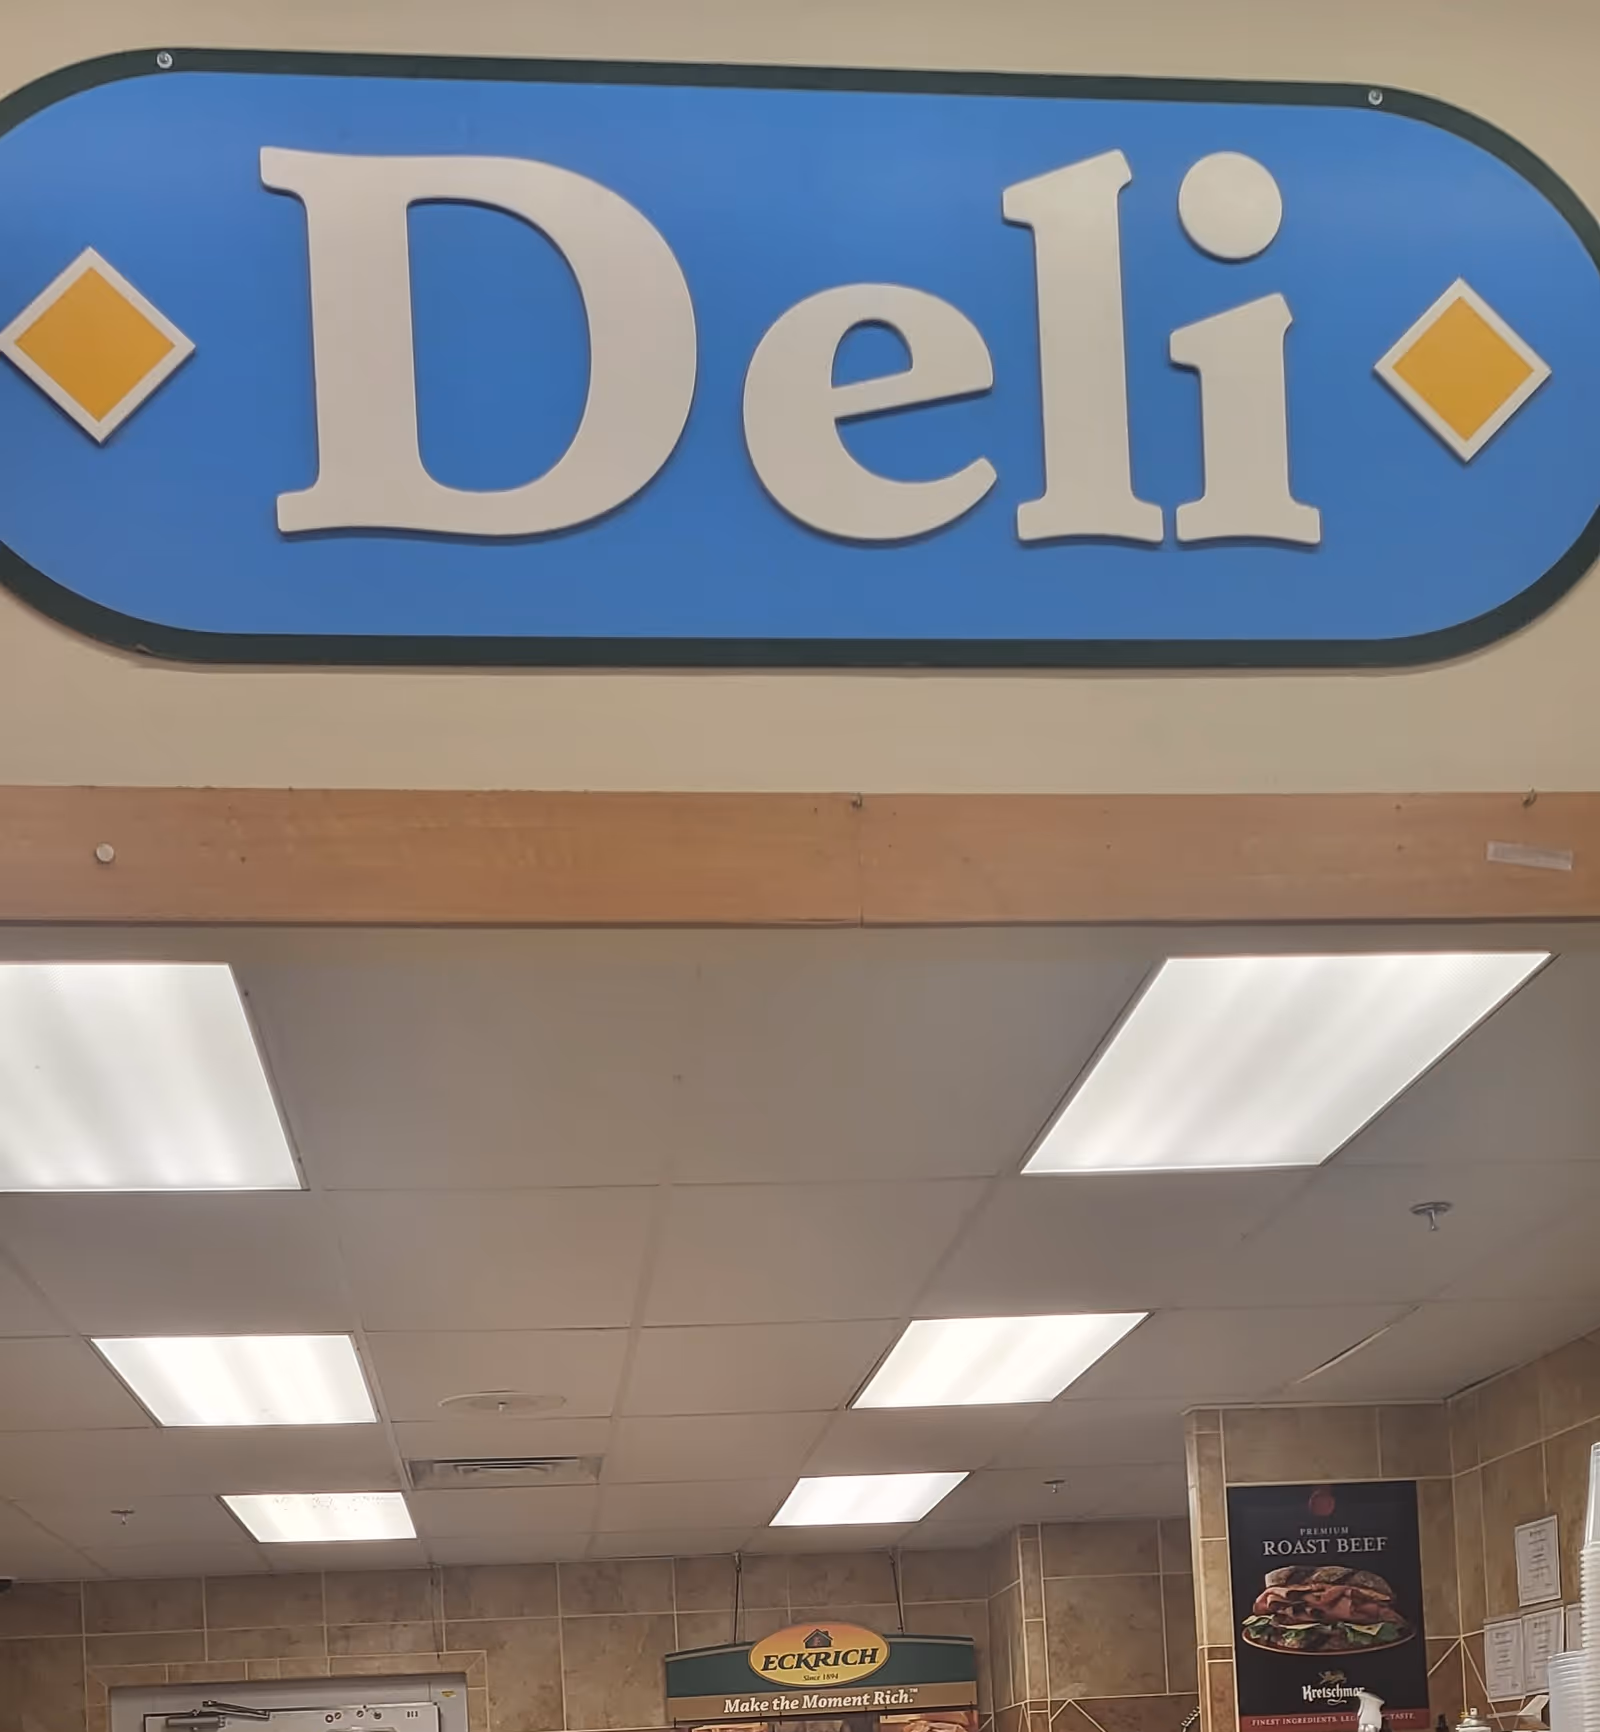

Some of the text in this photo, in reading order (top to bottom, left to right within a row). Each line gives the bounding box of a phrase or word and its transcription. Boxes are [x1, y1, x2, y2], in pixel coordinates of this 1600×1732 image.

[260, 146, 1321, 544] Deli
[1300, 1527, 1349, 1536] PREMIUM
[1263, 1537, 1388, 1556] ROAST BEEF
[761, 1648, 879, 1671] ECKRICH
[802, 1673, 839, 1682] Since 1894
[724, 1696, 769, 1713] Make
[772, 1695, 799, 1711] the
[802, 1691, 870, 1710] Moment
